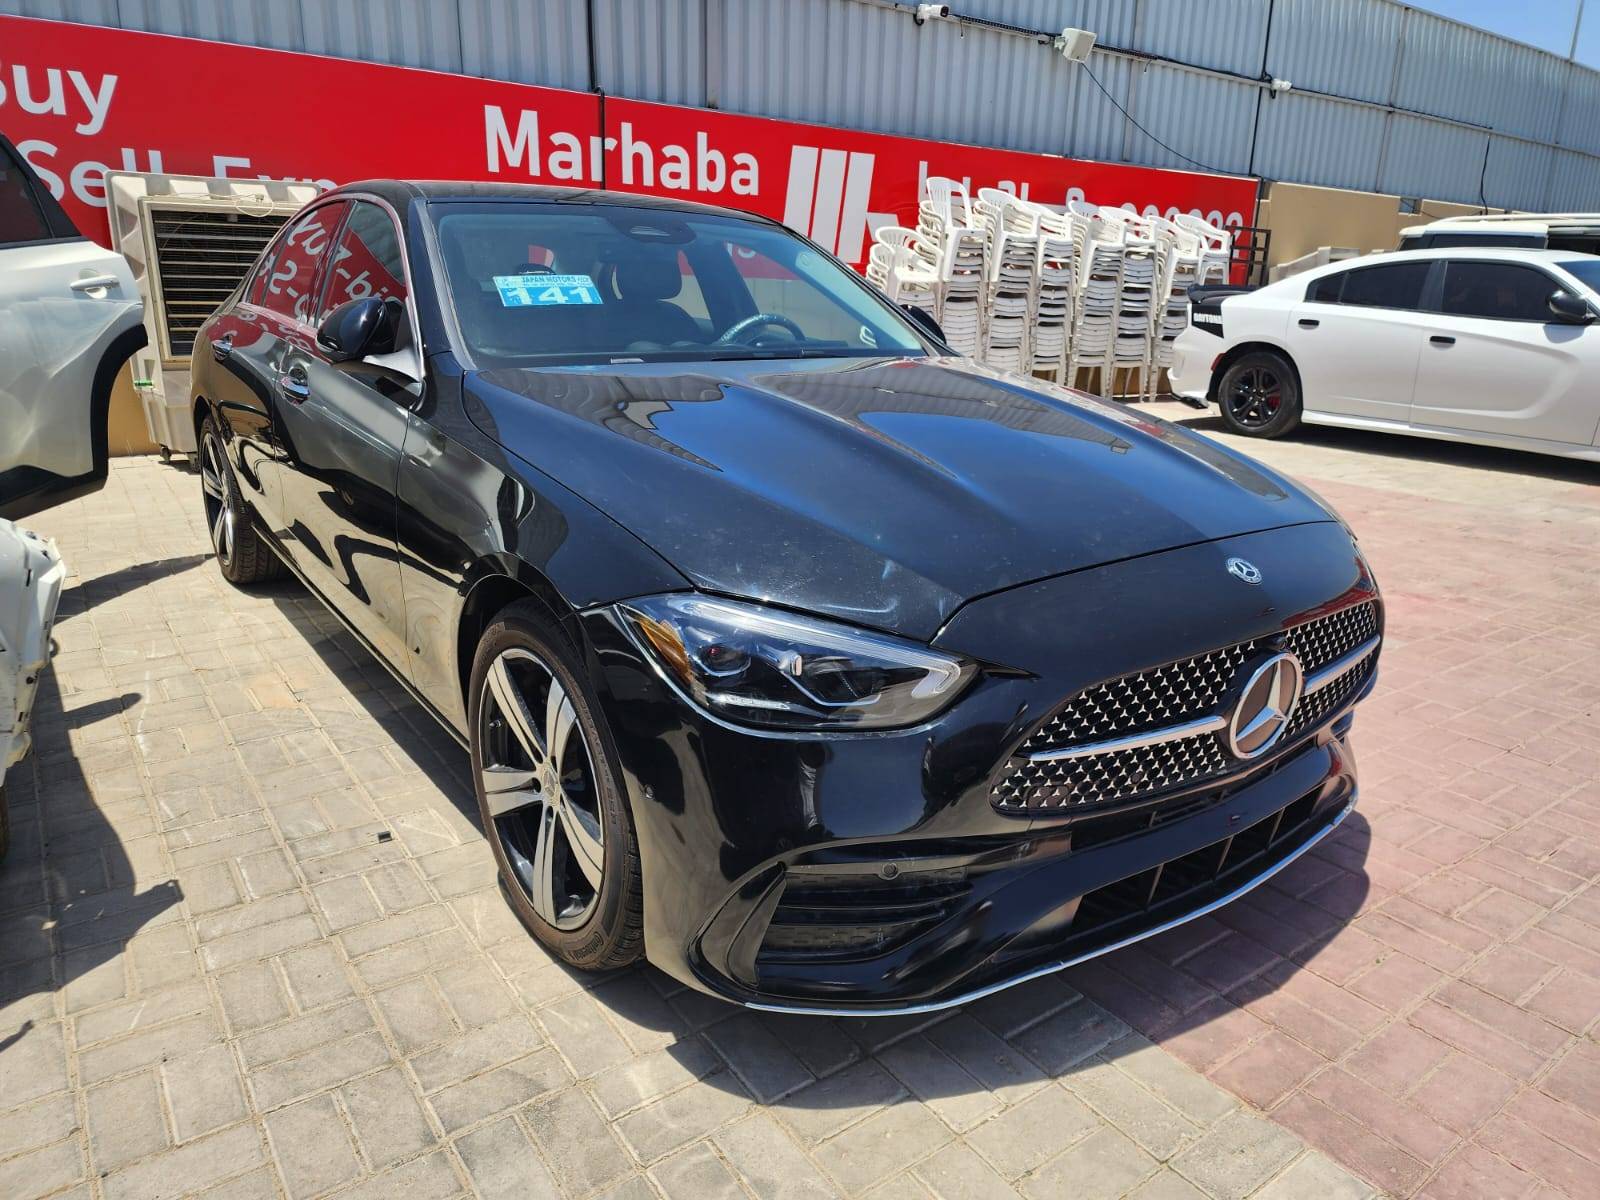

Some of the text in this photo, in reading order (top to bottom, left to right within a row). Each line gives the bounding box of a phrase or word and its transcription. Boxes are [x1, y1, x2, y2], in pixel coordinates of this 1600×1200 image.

[0, 60, 118, 136] uy
[484, 104, 760, 197] Marhaba
[507, 286, 593, 305] 141
